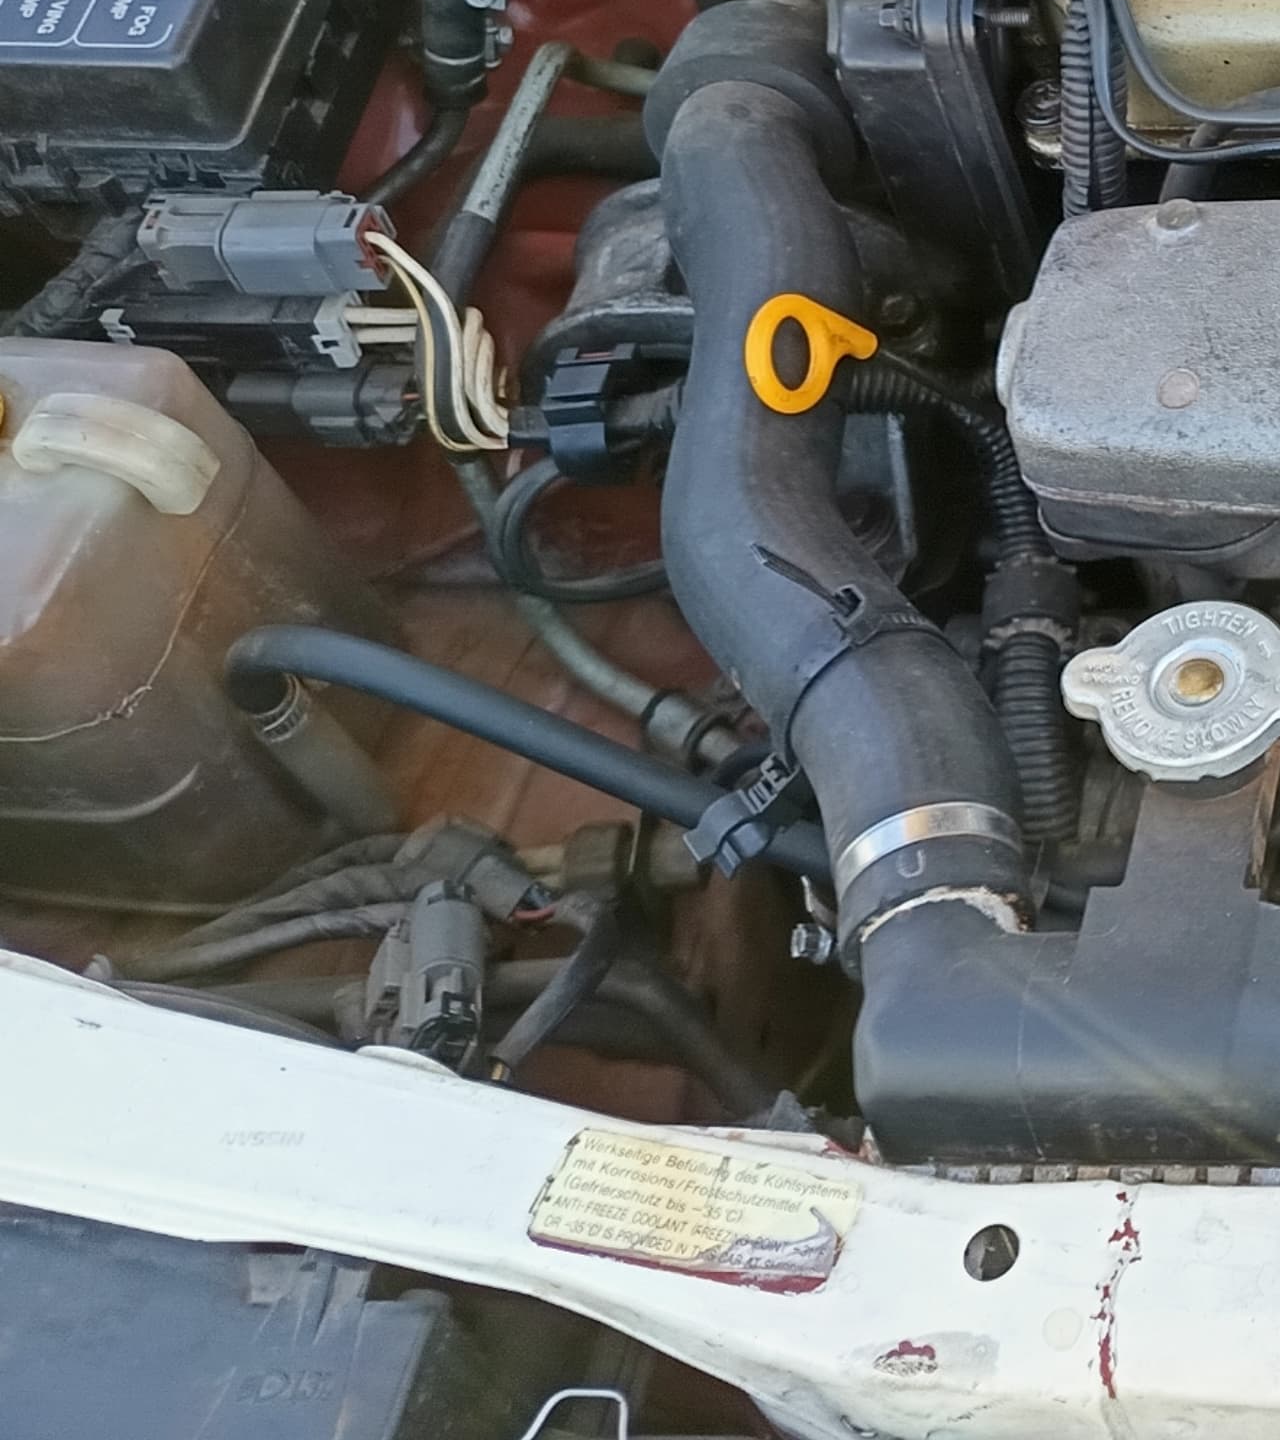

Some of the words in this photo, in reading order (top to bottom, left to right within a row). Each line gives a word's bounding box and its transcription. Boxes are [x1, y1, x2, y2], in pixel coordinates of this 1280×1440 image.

[128, 5, 157, 37] FOG
[1161, 609, 1260, 639] TIGHTEN
[1111, 687, 1178, 749] REMOVE
[1183, 694, 1267, 752] SLOWLY
[584, 1137, 662, 1166] Werkseitige
[735, 1168, 758, 1185] des
[665, 1197, 687, 1212] bis
[631, 1211, 689, 1233] COOLANT
[615, 1228, 673, 1253] PROVIDED
